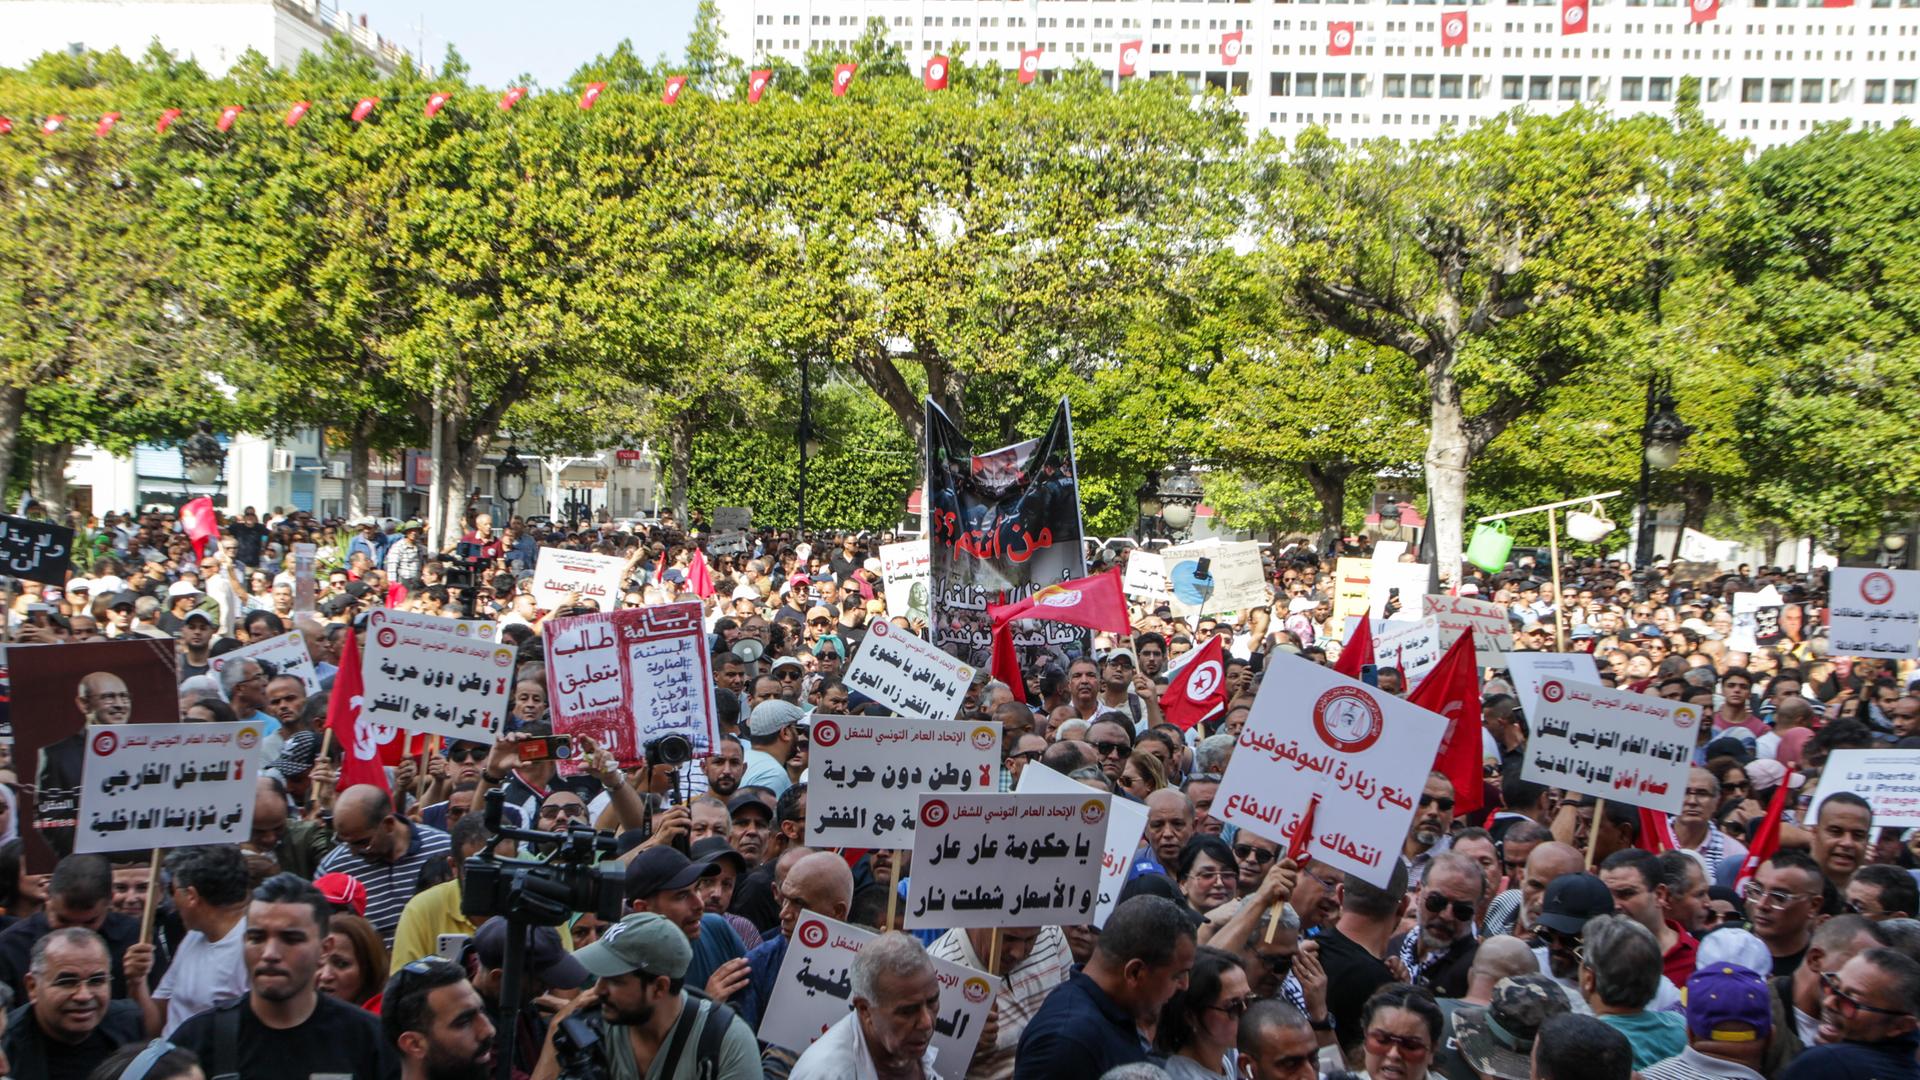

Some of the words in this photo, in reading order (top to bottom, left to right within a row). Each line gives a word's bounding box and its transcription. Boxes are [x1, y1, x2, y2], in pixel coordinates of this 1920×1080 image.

[1007, 522, 1053, 563] من
[555, 626, 615, 658] طالب
[869, 644, 903, 668] مقموع
[380, 657, 419, 682] حرية
[423, 668, 454, 688] دون
[558, 664, 620, 694] بتعليق
[850, 667, 883, 689] الجوع
[912, 667, 946, 692] مواطن
[458, 673, 491, 696] وطن
[496, 677, 507, 695] لا
[883, 684, 902, 704] زاد
[368, 693, 409, 713] الفقر
[412, 704, 430, 721] مع
[569, 692, 620, 711] سداد
[899, 695, 931, 716] الفقر
[434, 703, 478, 729] كرامة
[1537, 717, 1570, 738] للشغل
[844, 728, 873, 741] للشغل
[875, 729, 908, 746] التونسي
[911, 729, 935, 742] العام
[937, 731, 966, 746] الإتحاد
[1570, 729, 1620, 750] التونسي
[1620, 735, 1649, 756] العام
[1239, 728, 1336, 776] الموقوفين
[1535, 751, 1574, 774] المدنية
[1651, 741, 1689, 766] الإتحاد
[101, 763, 171, 796] الخارجي
[173, 760, 231, 790] للتدخل
[233, 759, 245, 781] لا
[823, 759, 876, 789] حرية
[881, 765, 922, 790] دون
[928, 762, 972, 791] وطن
[978, 763, 991, 786] لا
[1335, 762, 1377, 801] زيارة
[1576, 759, 1614, 784] للدولة
[1614, 768, 1640, 790] أمان
[1223, 794, 1282, 826] الدفاع
[1377, 785, 1414, 812] منع
[90, 807, 161, 838] الداخلية
[162, 805, 218, 833] شؤوننا
[219, 803, 244, 833] في
[814, 806, 867, 834] الفقر
[872, 812, 896, 836] مع
[952, 806, 983, 821] للشغل
[984, 806, 1018, 824] التونسي
[1020, 805, 1045, 818] العام
[1047, 804, 1076, 821] الإتحاد
[928, 833, 961, 866] عار
[967, 833, 998, 866] عار
[1004, 832, 1071, 864] حكومة
[1075, 832, 1091, 865] يا
[1319, 832, 1383, 868] انتهاك
[913, 886, 946, 917] نار
[952, 884, 1005, 910] شعلت
[1009, 877, 1076, 916] الأسعار
[830, 936, 864, 953] للشغل
[796, 956, 852, 1000] طنية
